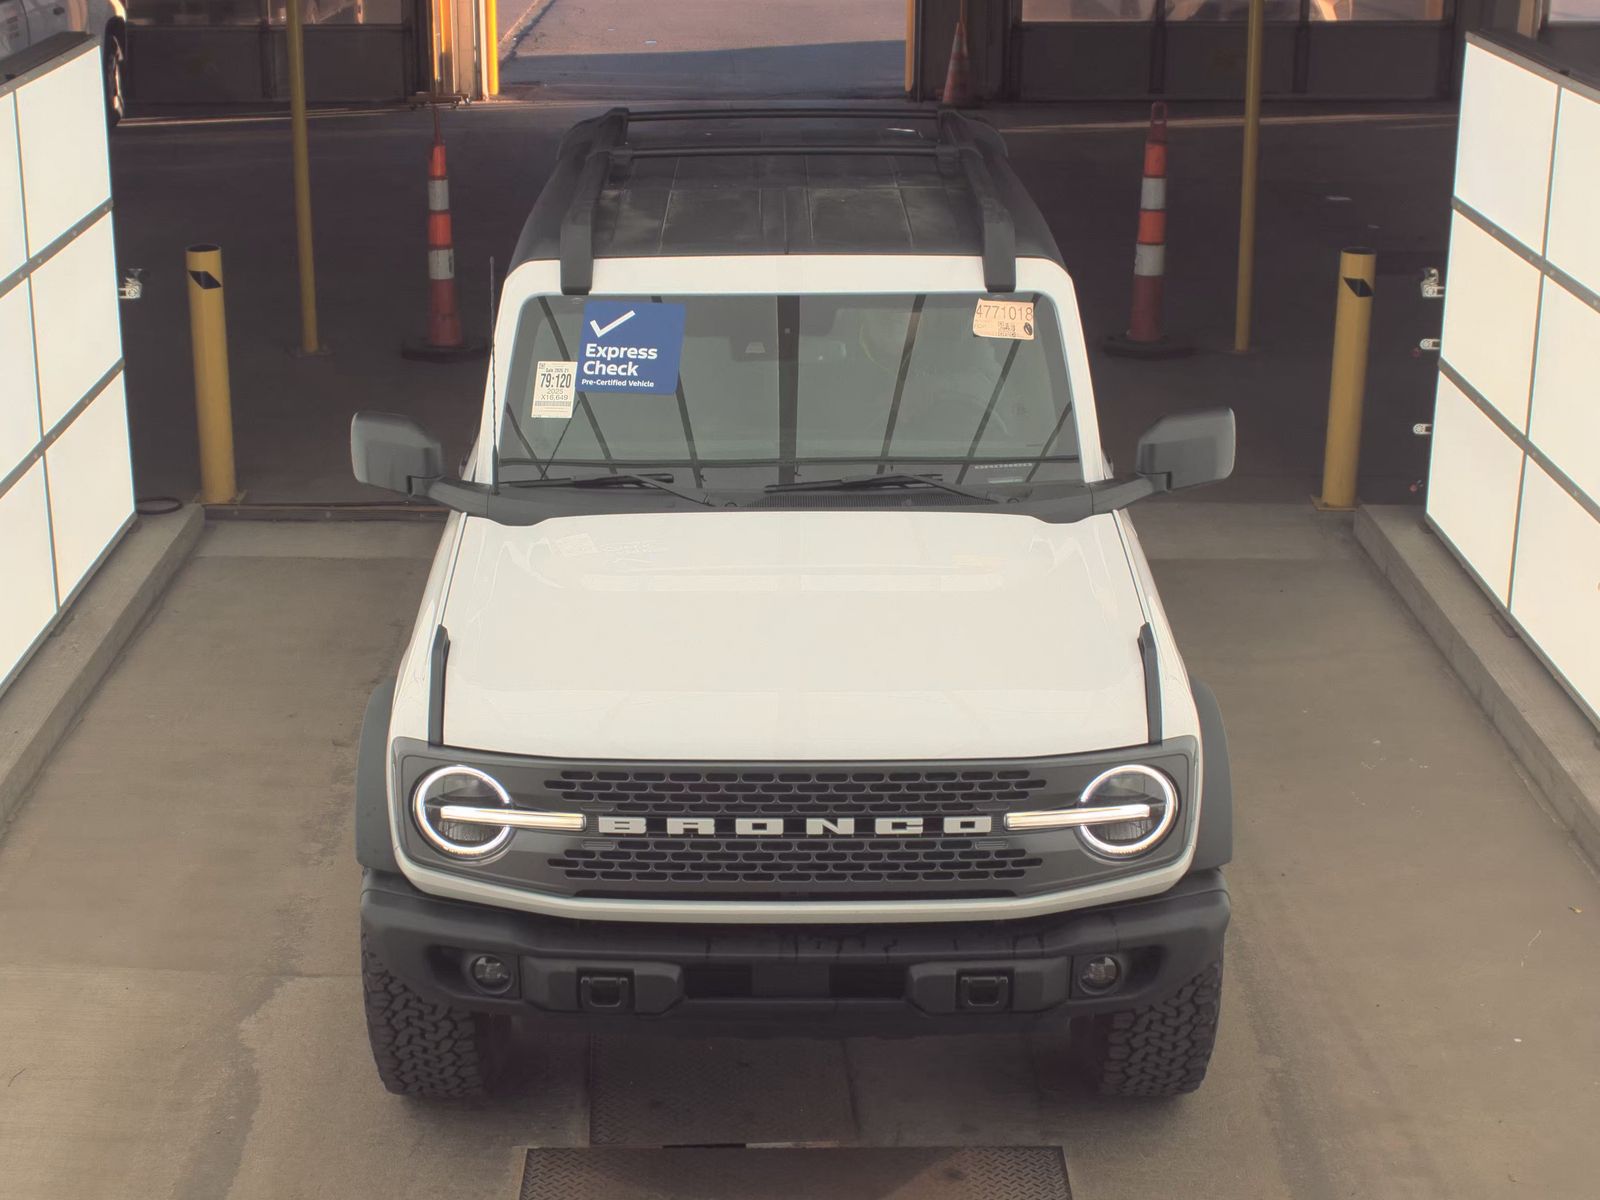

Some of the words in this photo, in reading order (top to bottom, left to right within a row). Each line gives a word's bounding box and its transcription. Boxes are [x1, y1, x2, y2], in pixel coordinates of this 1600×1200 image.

[976, 304, 1033, 321] 4771018
[585, 343, 658, 361] Express
[583, 360, 639, 376] Check
[540, 373, 572, 389] 79:120
[581, 378, 627, 387] Pre-Certified
[628, 379, 655, 388] Vehicle
[598, 815, 992, 836] BRONCO
